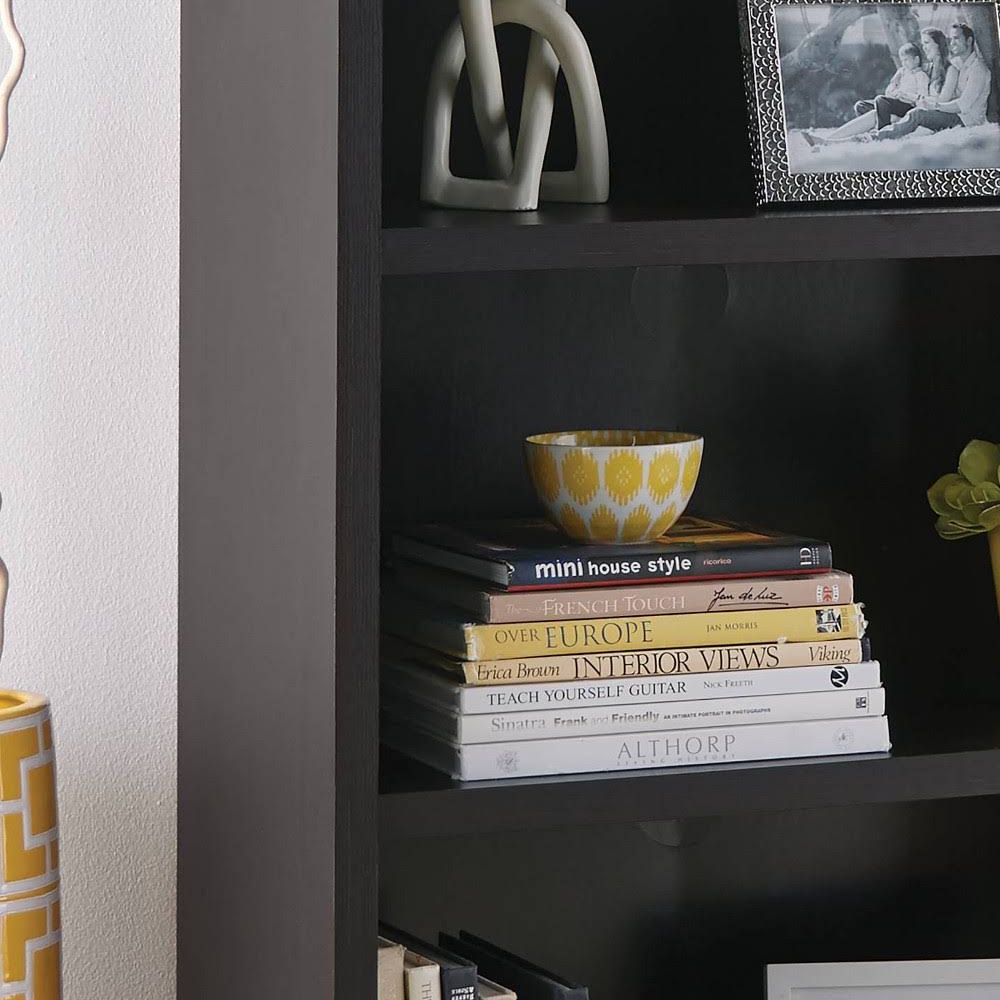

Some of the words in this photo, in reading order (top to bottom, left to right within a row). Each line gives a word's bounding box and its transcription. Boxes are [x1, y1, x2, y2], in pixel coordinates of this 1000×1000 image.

[535, 558, 584, 579] mini
[588, 560, 641, 576] house
[647, 555, 692, 577] style
[542, 597, 618, 617] FRENCH
[621, 594, 687, 613] TOUCH
[738, 586, 753, 600] de
[494, 628, 541, 645] OVER
[545, 619, 654, 649] EUROPE
[707, 623, 722, 633] JAN
[725, 621, 759, 631] MORRIS
[477, 663, 513, 682] Erica
[517, 662, 562, 678] Brown
[572, 650, 692, 680] INTERIOR
[700, 645, 780, 671] VIEWS
[808, 645, 853, 663] Viking
[487, 690, 540, 707] TEACH
[543, 684, 625, 703] YOURSELF
[629, 680, 688, 698] GUITAR
[491, 715, 546, 733] Sinatra
[553, 715, 587, 729] Frank
[591, 715, 610, 726] and
[611, 711, 661, 728] Friendly
[617, 734, 737, 760] ALTHORP
